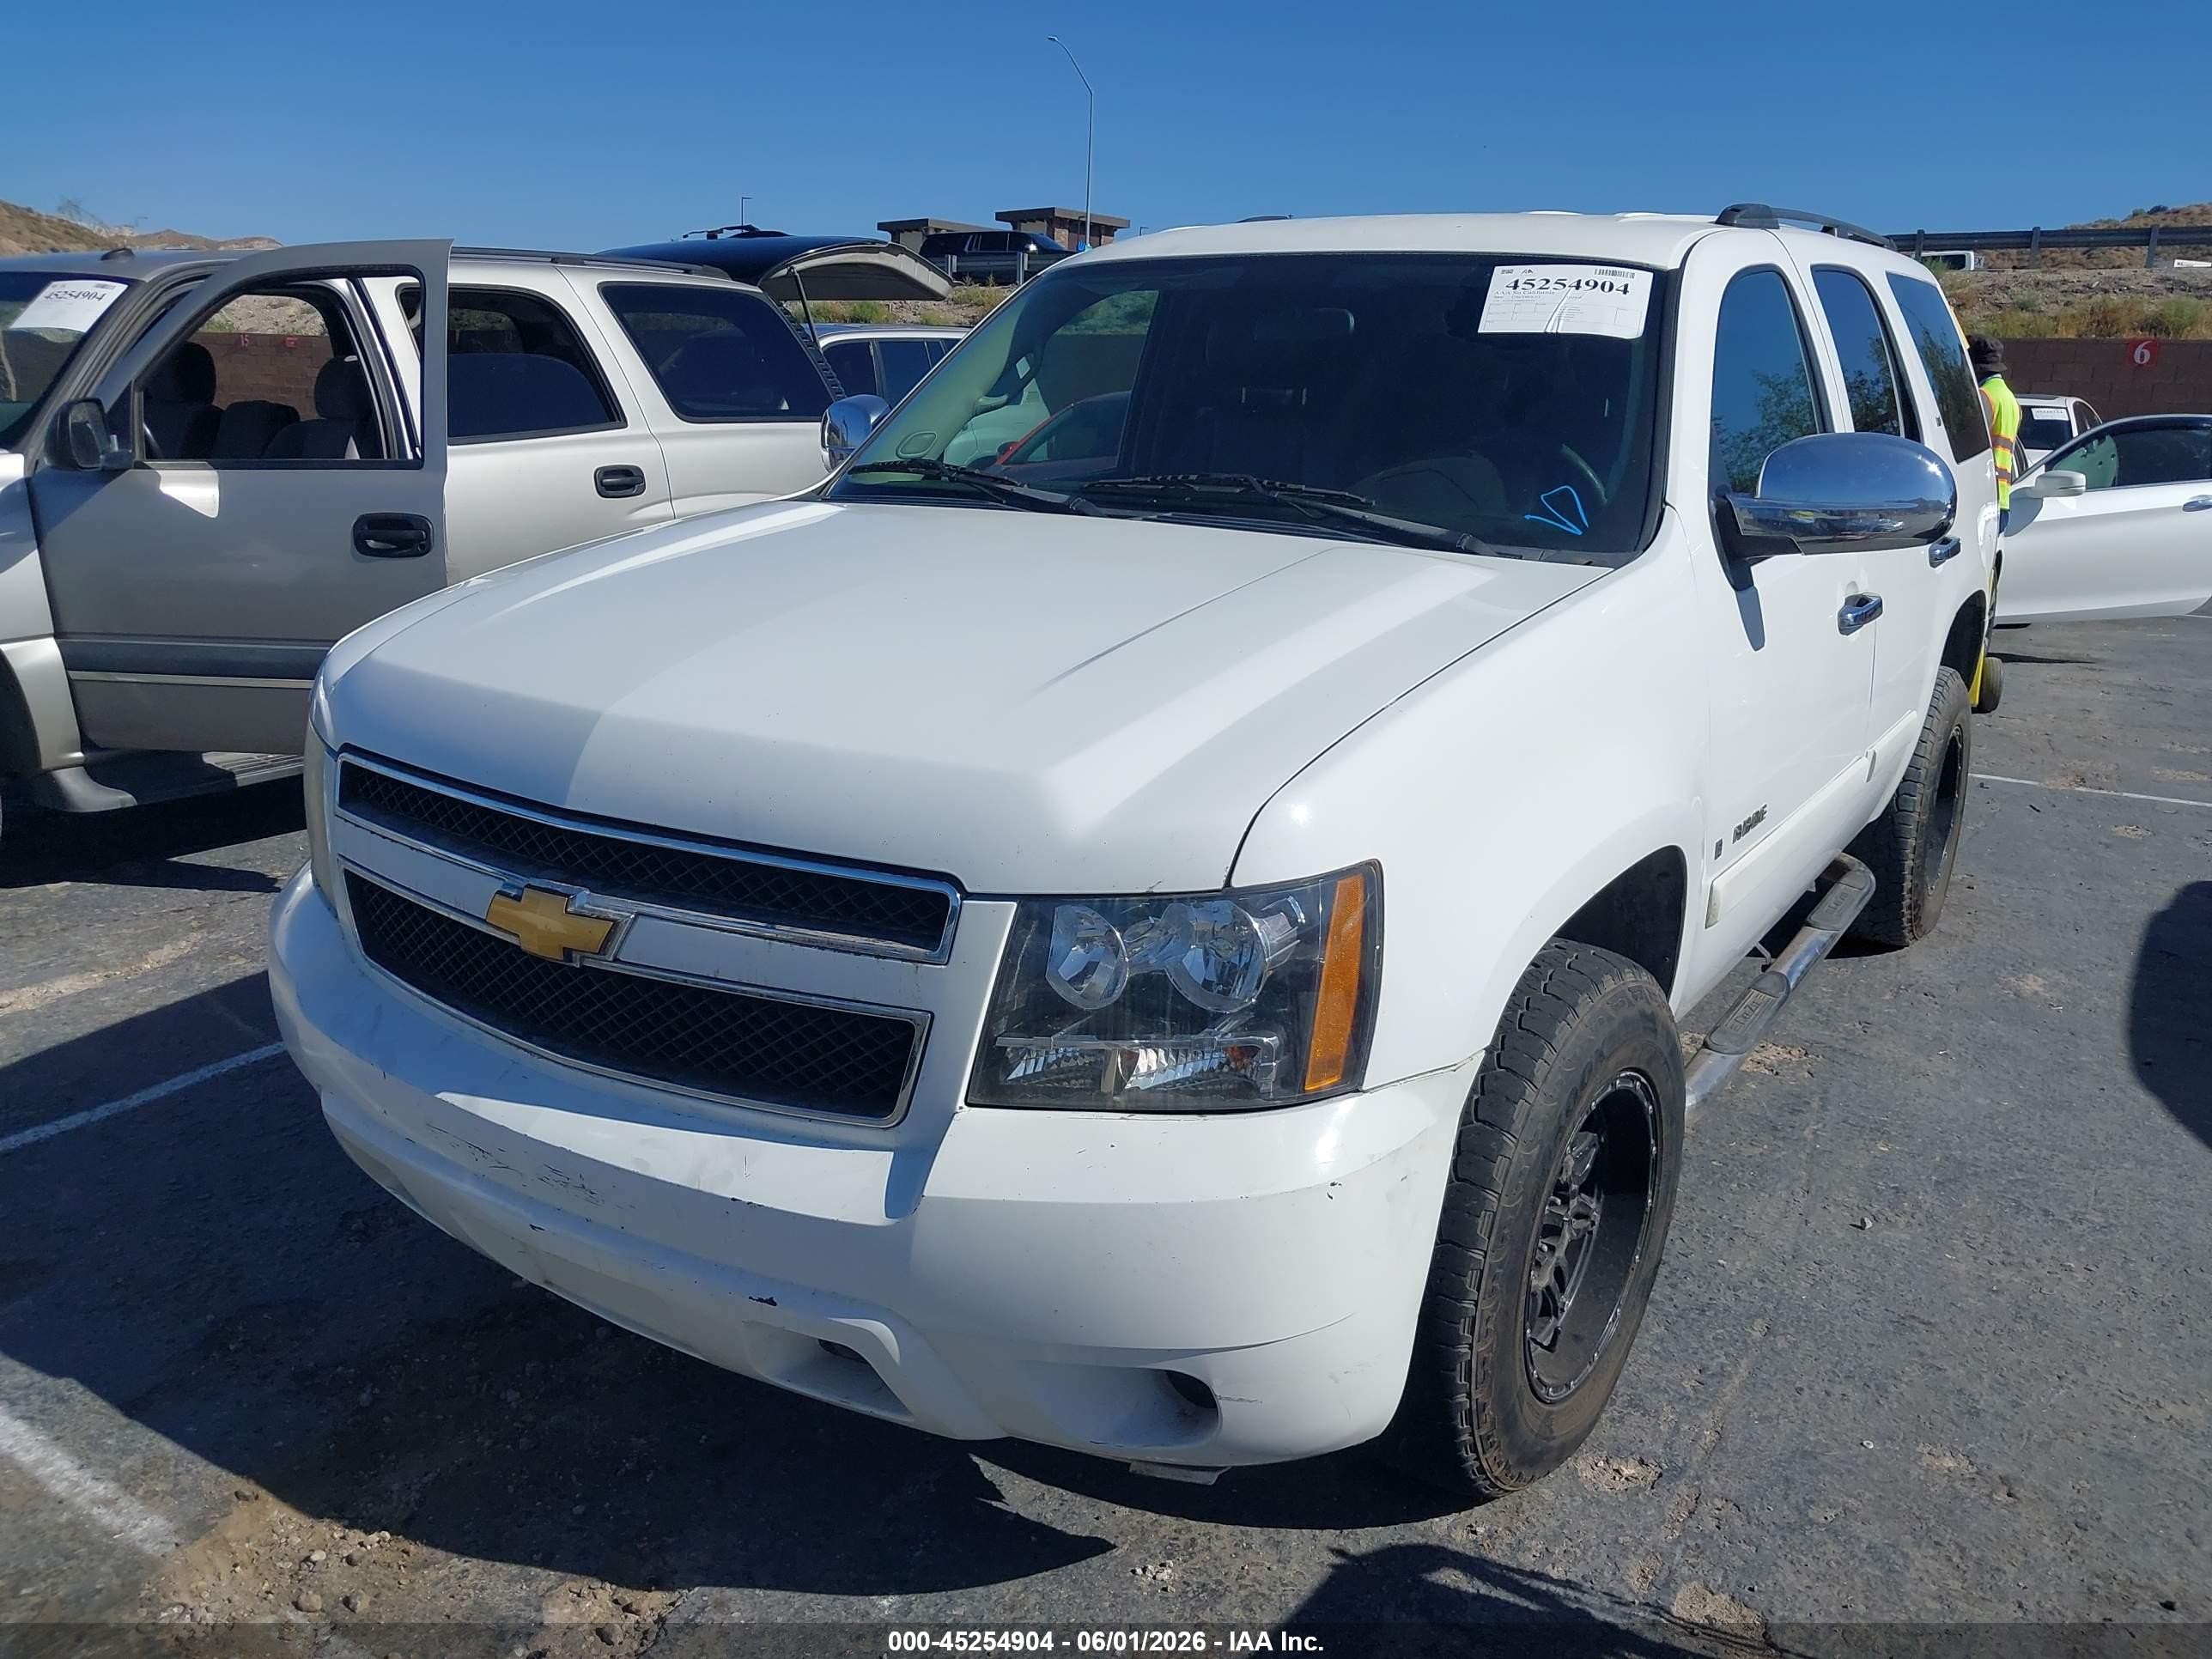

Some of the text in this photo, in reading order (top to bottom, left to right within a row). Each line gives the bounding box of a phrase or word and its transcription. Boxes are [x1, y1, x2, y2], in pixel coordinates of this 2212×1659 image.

[1505, 278, 1630, 295] 45254904
[44, 290, 107, 301] 45254904
[2134, 340, 2152, 364] 6
